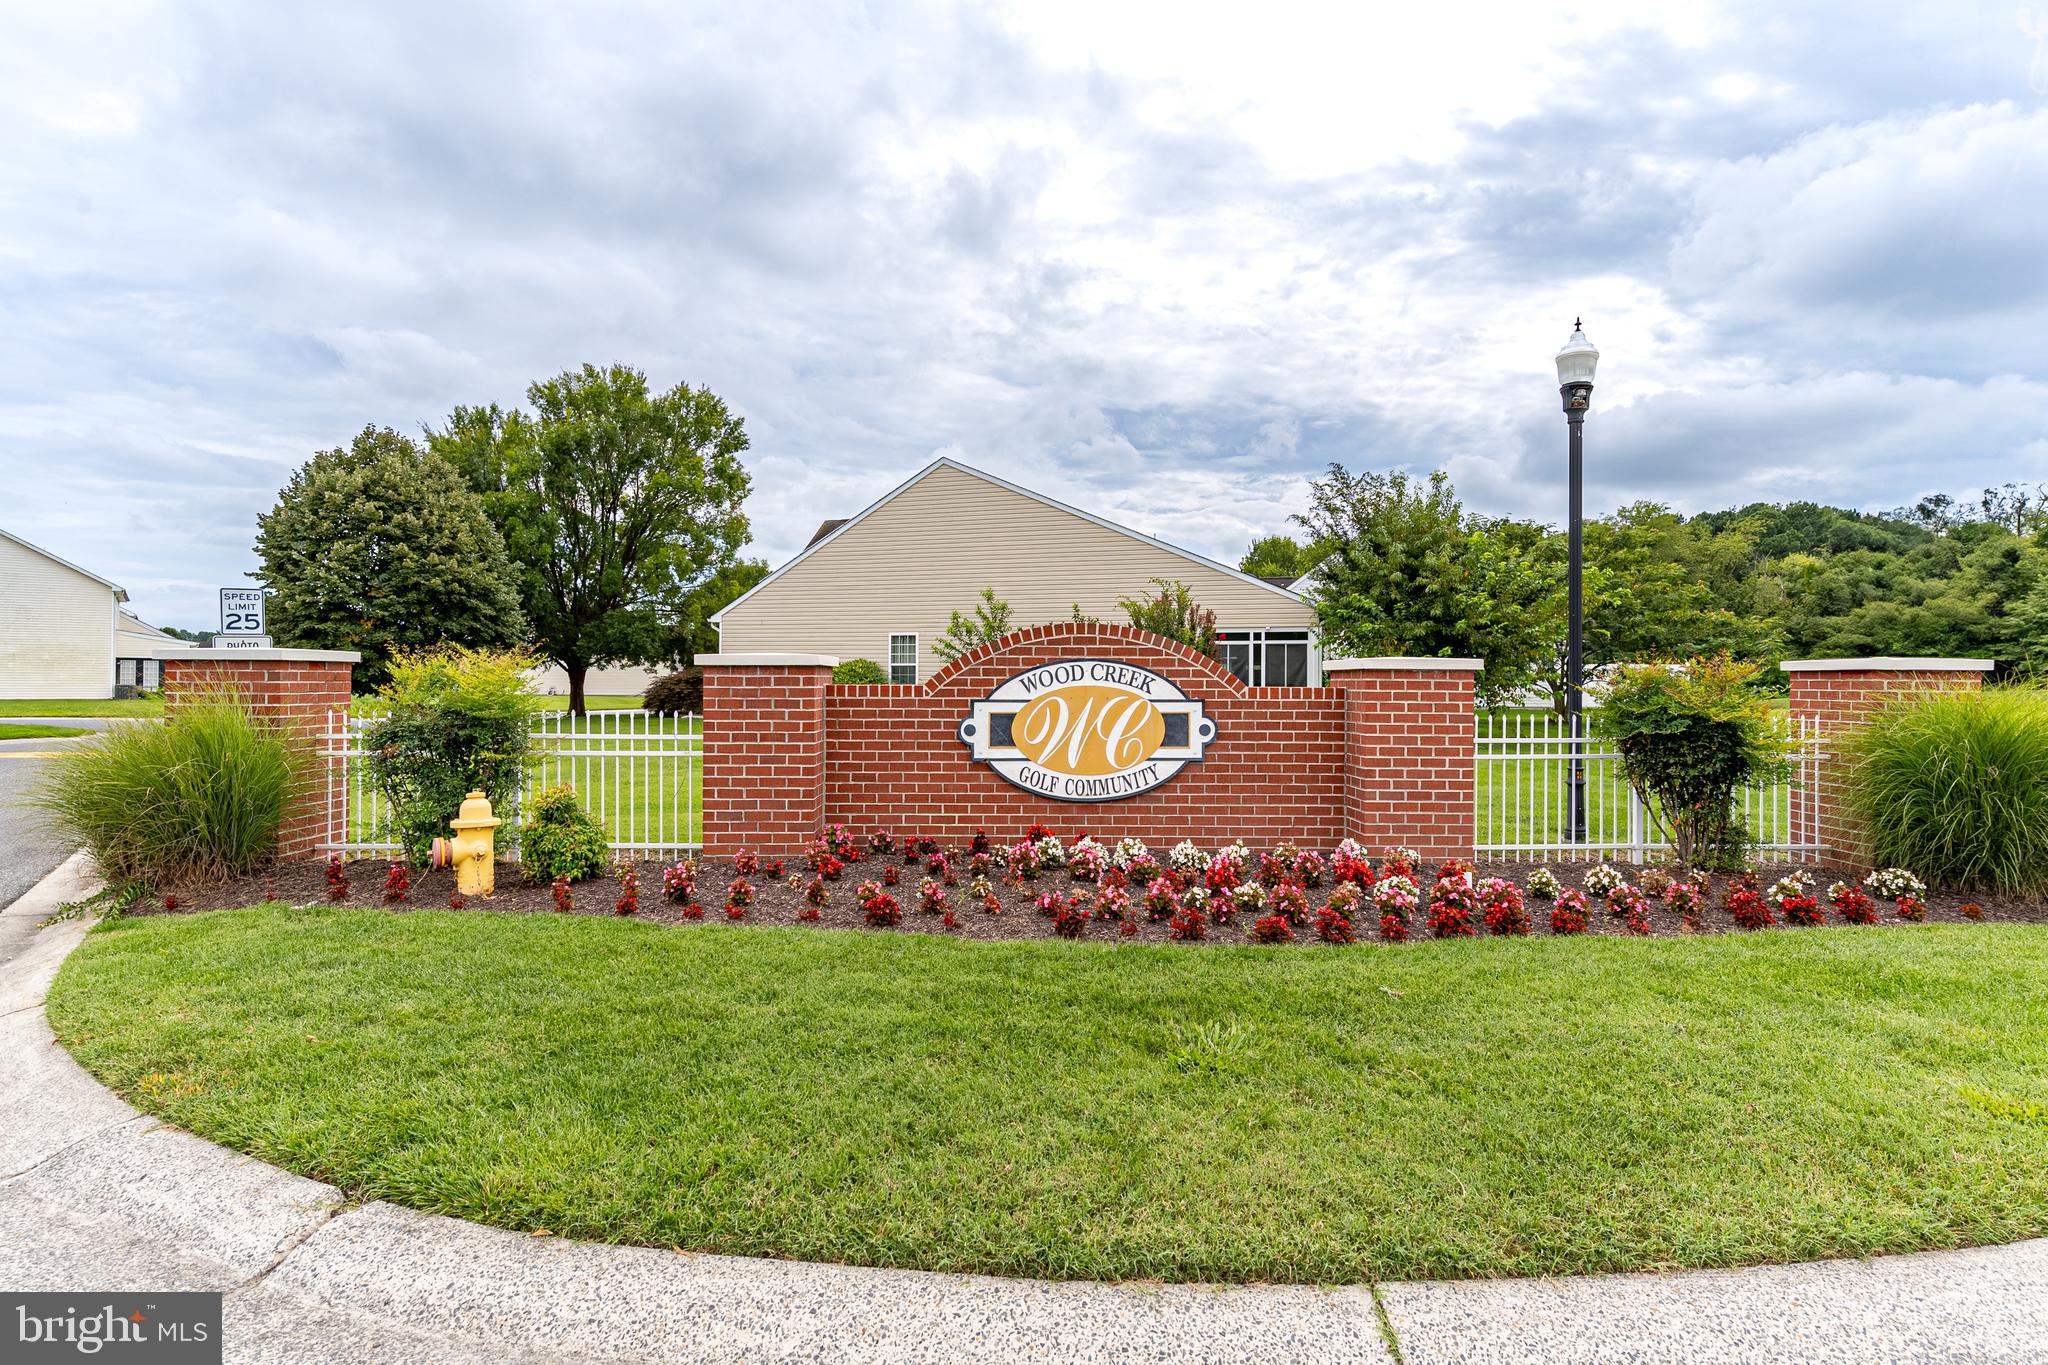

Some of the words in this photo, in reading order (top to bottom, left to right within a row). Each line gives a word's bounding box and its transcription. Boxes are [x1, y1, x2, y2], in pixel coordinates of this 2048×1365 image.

[226, 613, 260, 630] 25
[1019, 664, 1084, 694] WOOD
[1090, 663, 1156, 694] CREEK
[1019, 766, 1059, 793] GOLF
[1064, 764, 1160, 796] COMMUNITY
